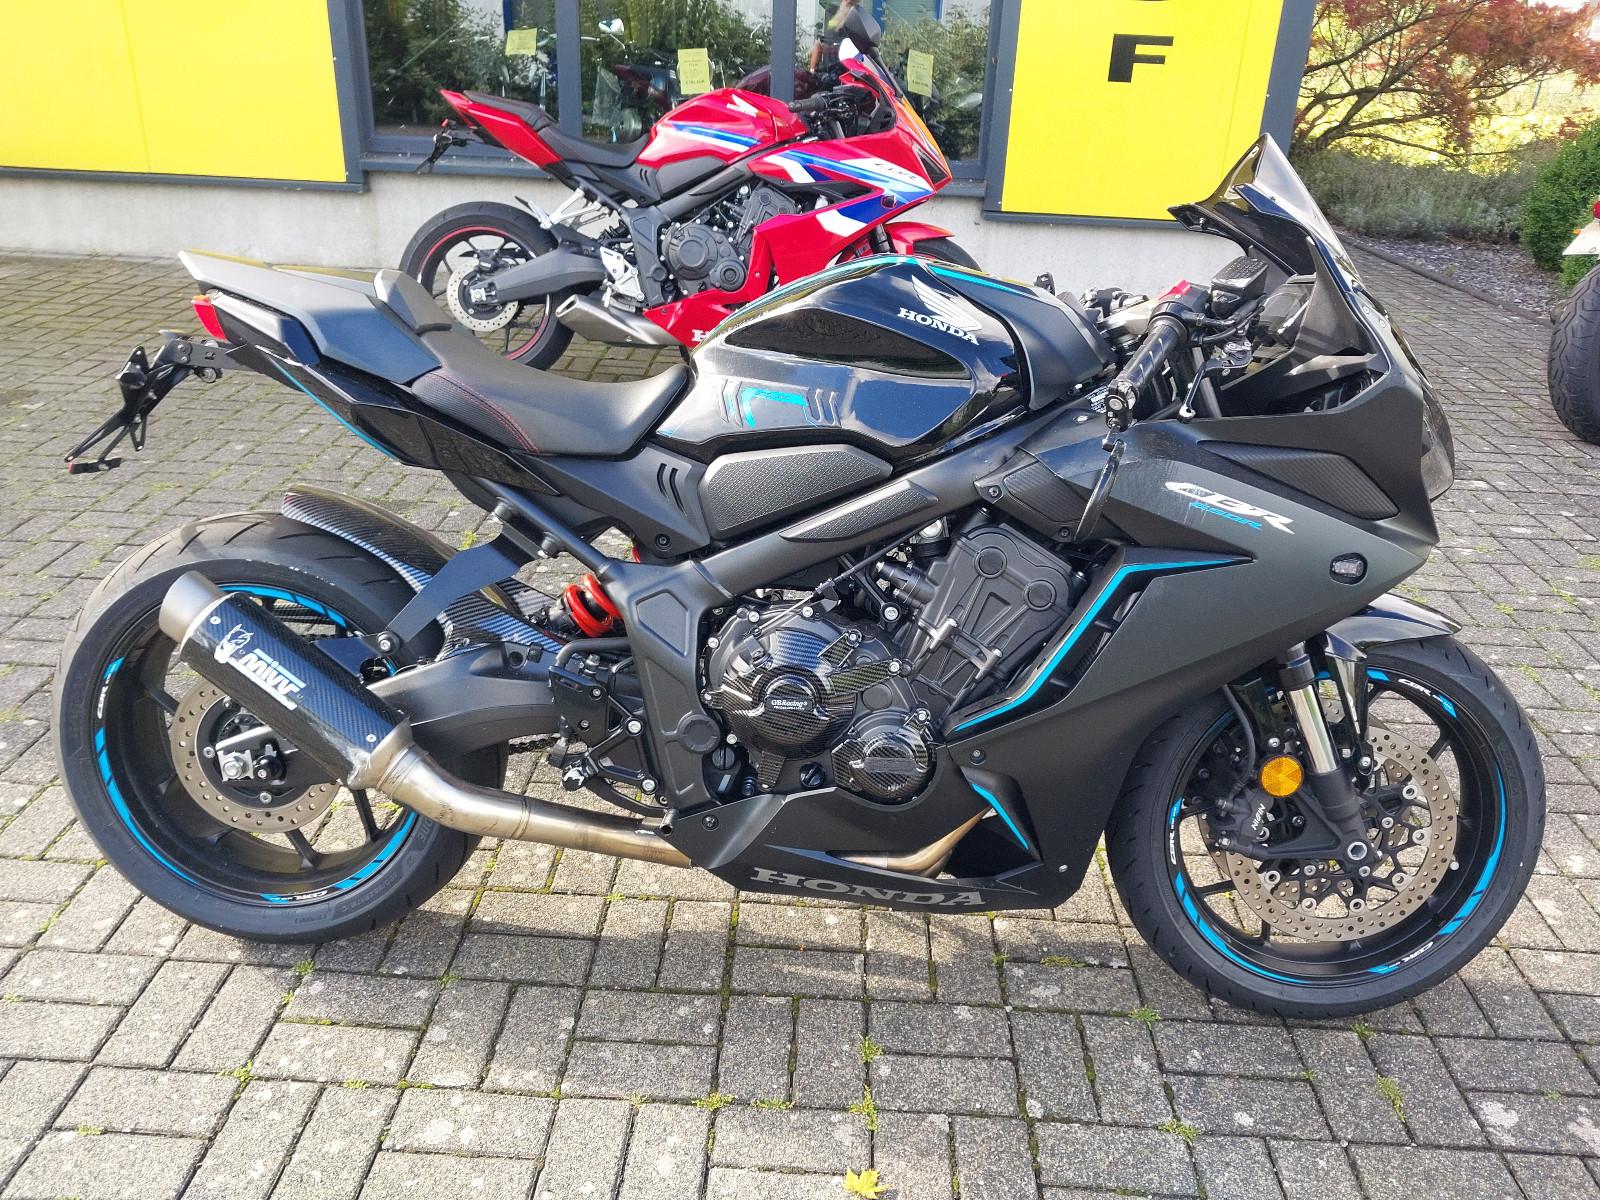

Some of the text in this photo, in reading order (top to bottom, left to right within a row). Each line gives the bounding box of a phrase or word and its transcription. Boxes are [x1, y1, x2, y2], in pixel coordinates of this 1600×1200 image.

[896, 307, 980, 346] HONDA
[1164, 481, 1296, 535] CBR
[749, 866, 986, 906] HONDA
